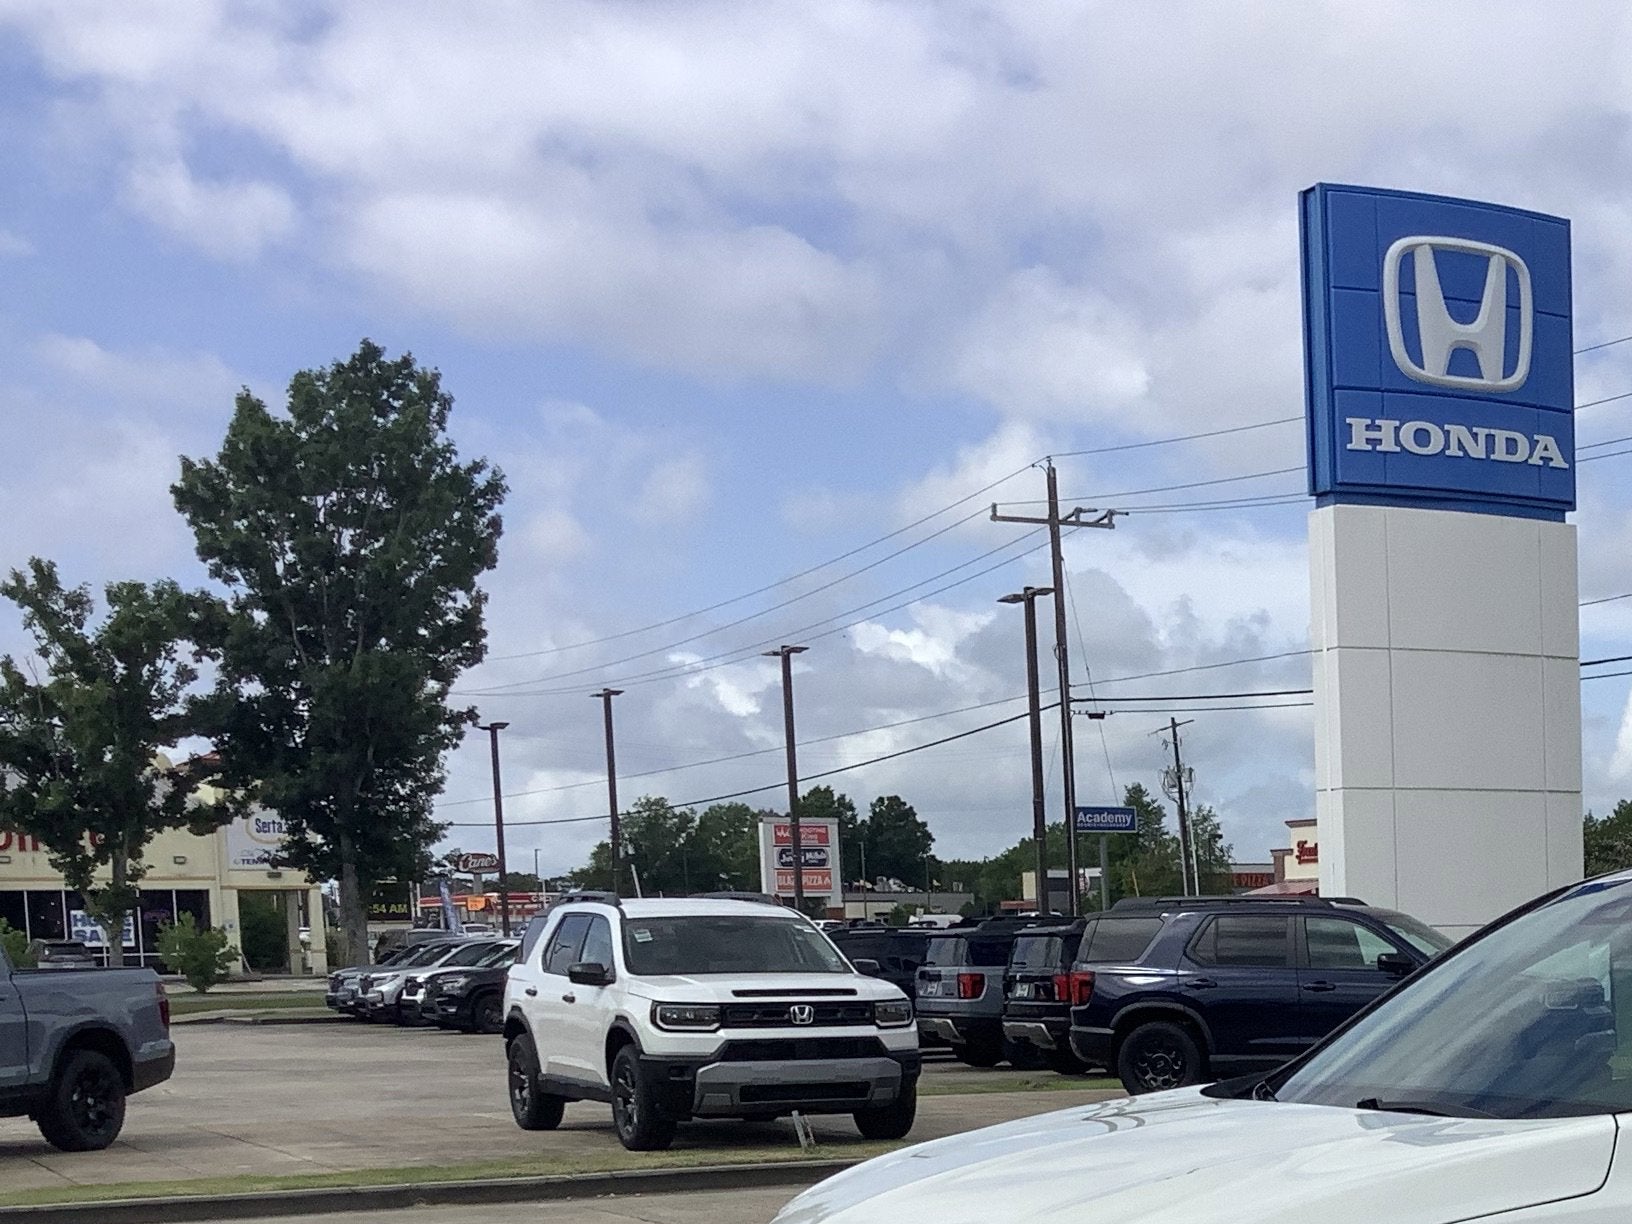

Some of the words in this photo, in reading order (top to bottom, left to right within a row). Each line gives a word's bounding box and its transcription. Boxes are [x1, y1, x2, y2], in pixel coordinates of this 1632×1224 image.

[1345, 417, 1569, 469] HONDA
[255, 818, 284, 833] Serta
[1077, 811, 1132, 827] Academy
[459, 854, 497, 871] Cane's
[73, 929, 133, 942] SAE
